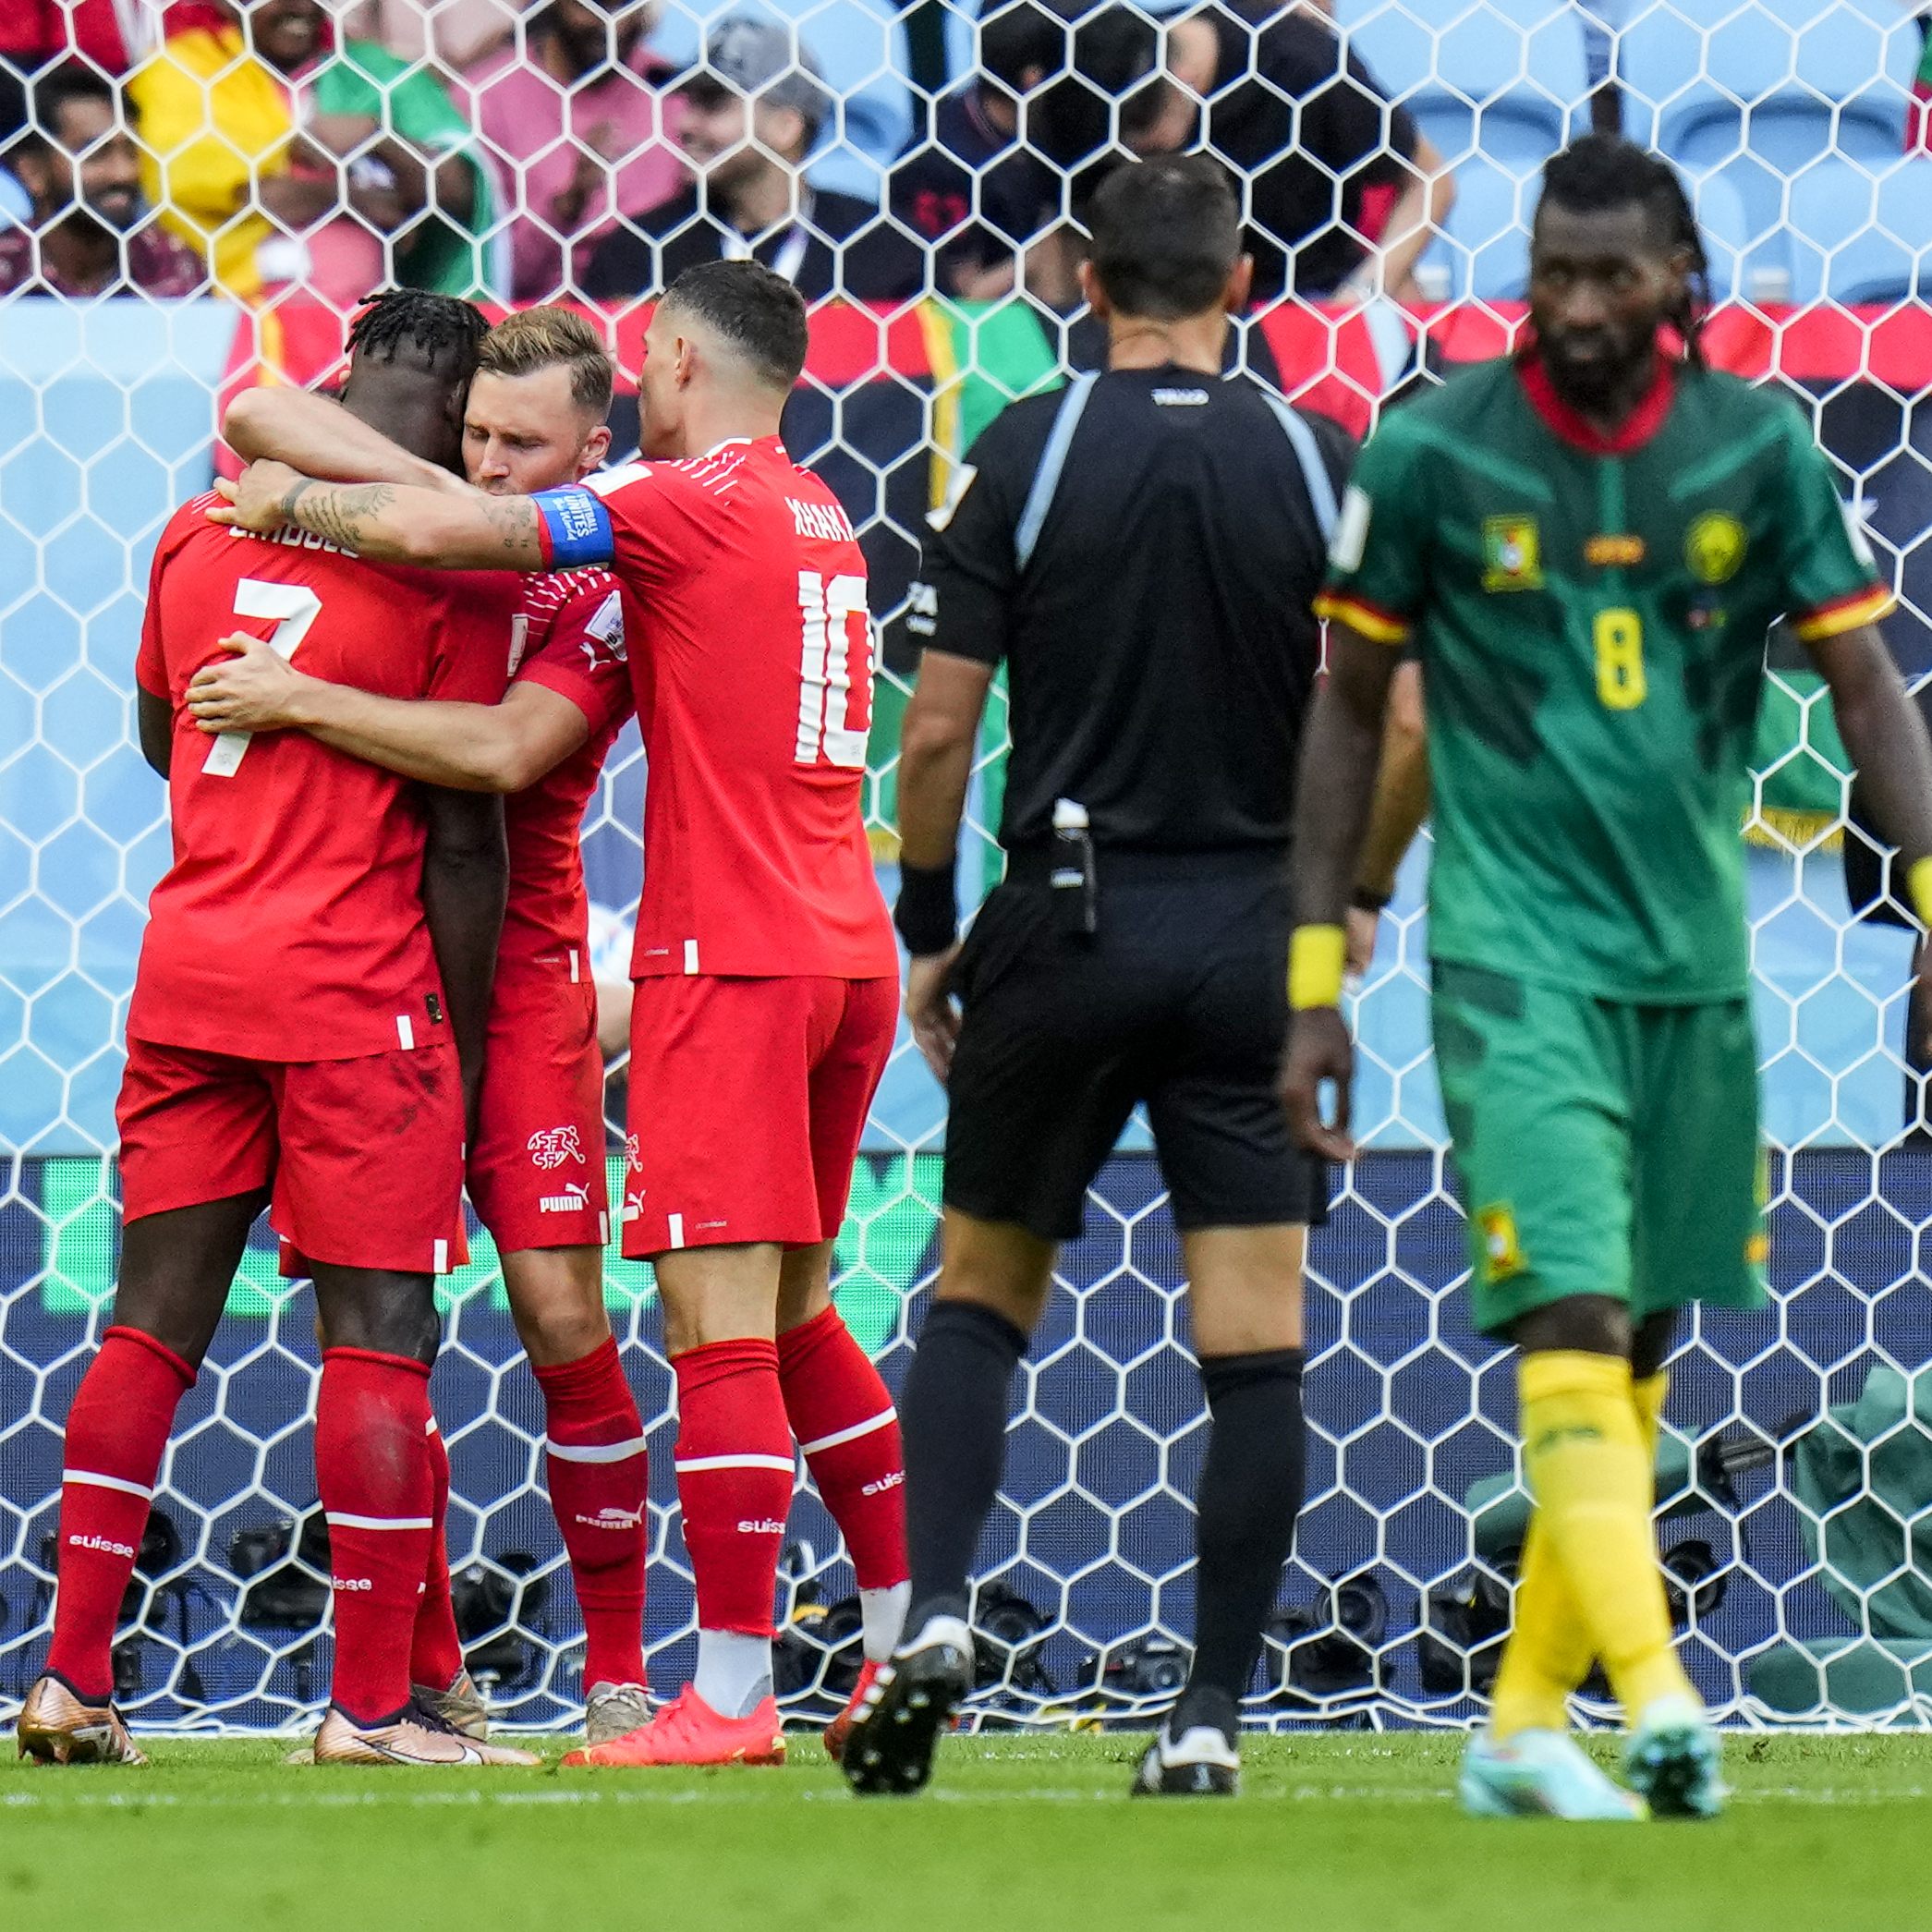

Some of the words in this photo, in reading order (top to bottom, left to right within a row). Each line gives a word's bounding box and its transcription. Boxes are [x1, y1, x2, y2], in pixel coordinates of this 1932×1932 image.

[564, 494, 589, 538] UNITES
[794, 570, 875, 767] 10
[1592, 606, 1647, 711] 8
[200, 577, 322, 777] 7
[539, 1195, 584, 1213] PUMA
[861, 1469, 906, 1496] suis
[737, 1517, 785, 1534] suiss
[68, 1534, 135, 1560] suisse
